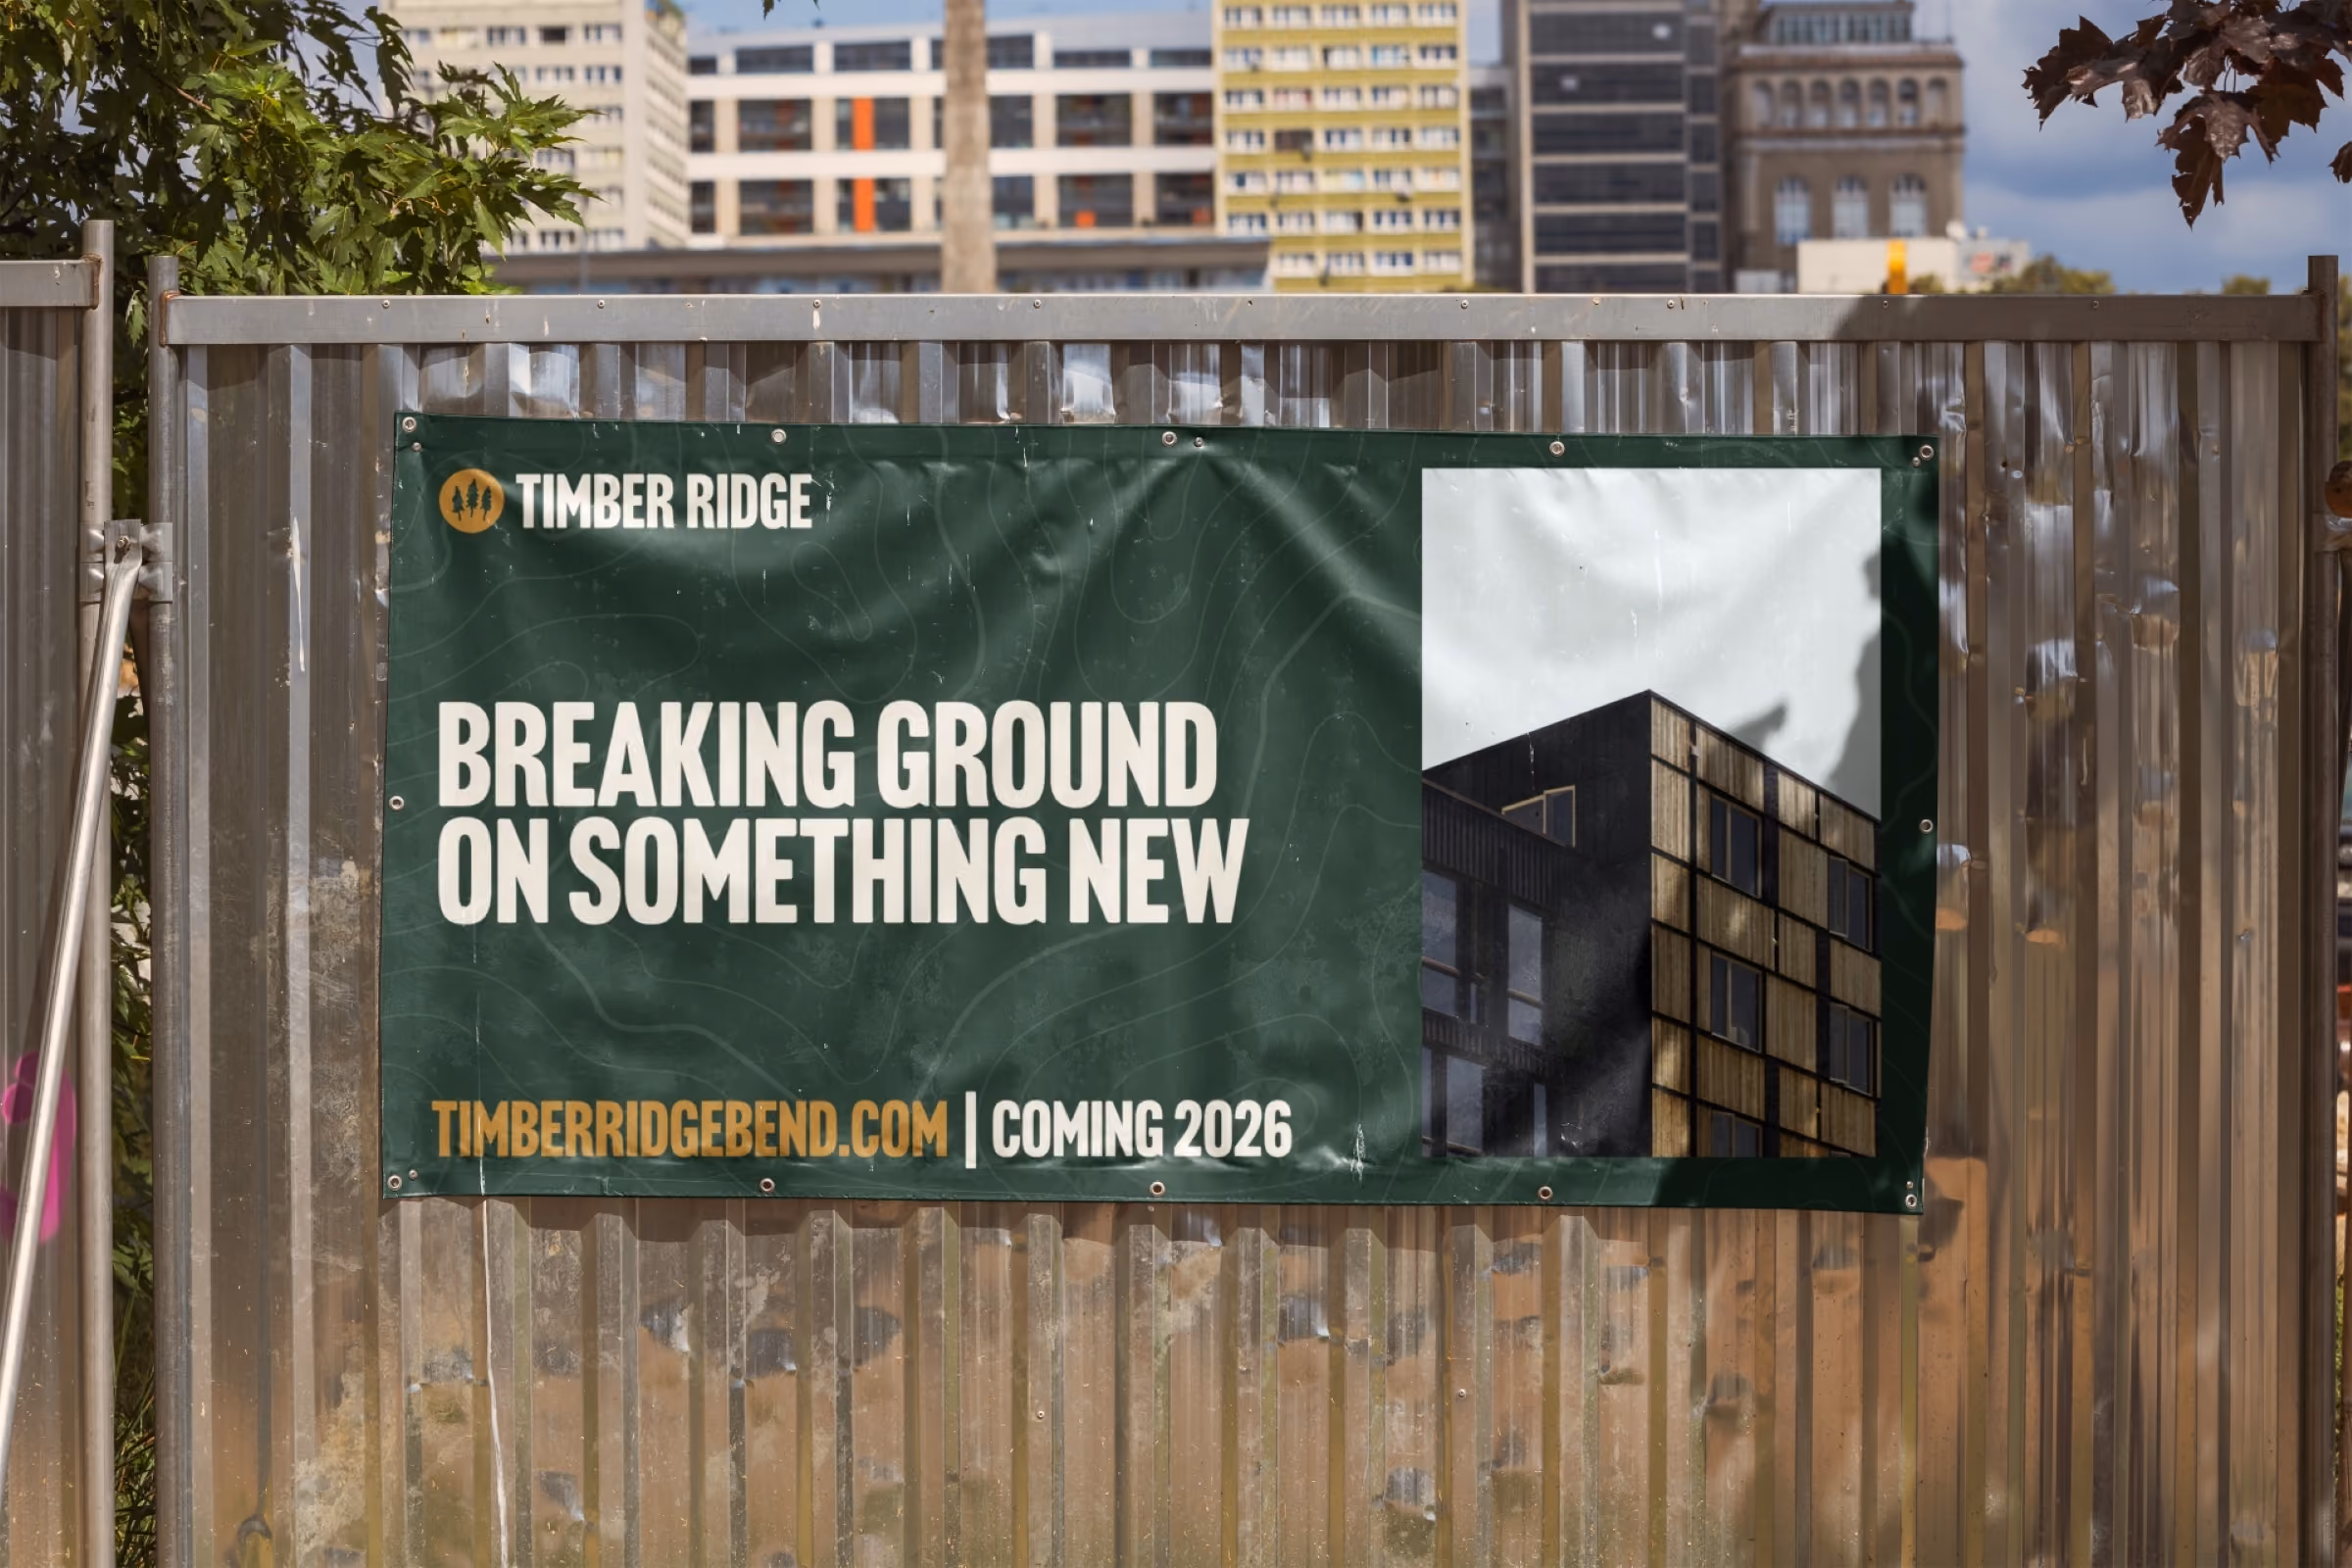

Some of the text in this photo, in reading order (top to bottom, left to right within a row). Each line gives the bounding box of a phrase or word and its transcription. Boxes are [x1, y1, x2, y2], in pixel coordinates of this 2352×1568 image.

[516, 473, 811, 529] TIMBER RIDGE
[438, 700, 1217, 808] BREAKING GROUND
[438, 816, 1249, 924] ON SOMETHING NEW
[432, 1100, 1292, 1158] TIMBERRIDGEBEND.COM COMING 2026
